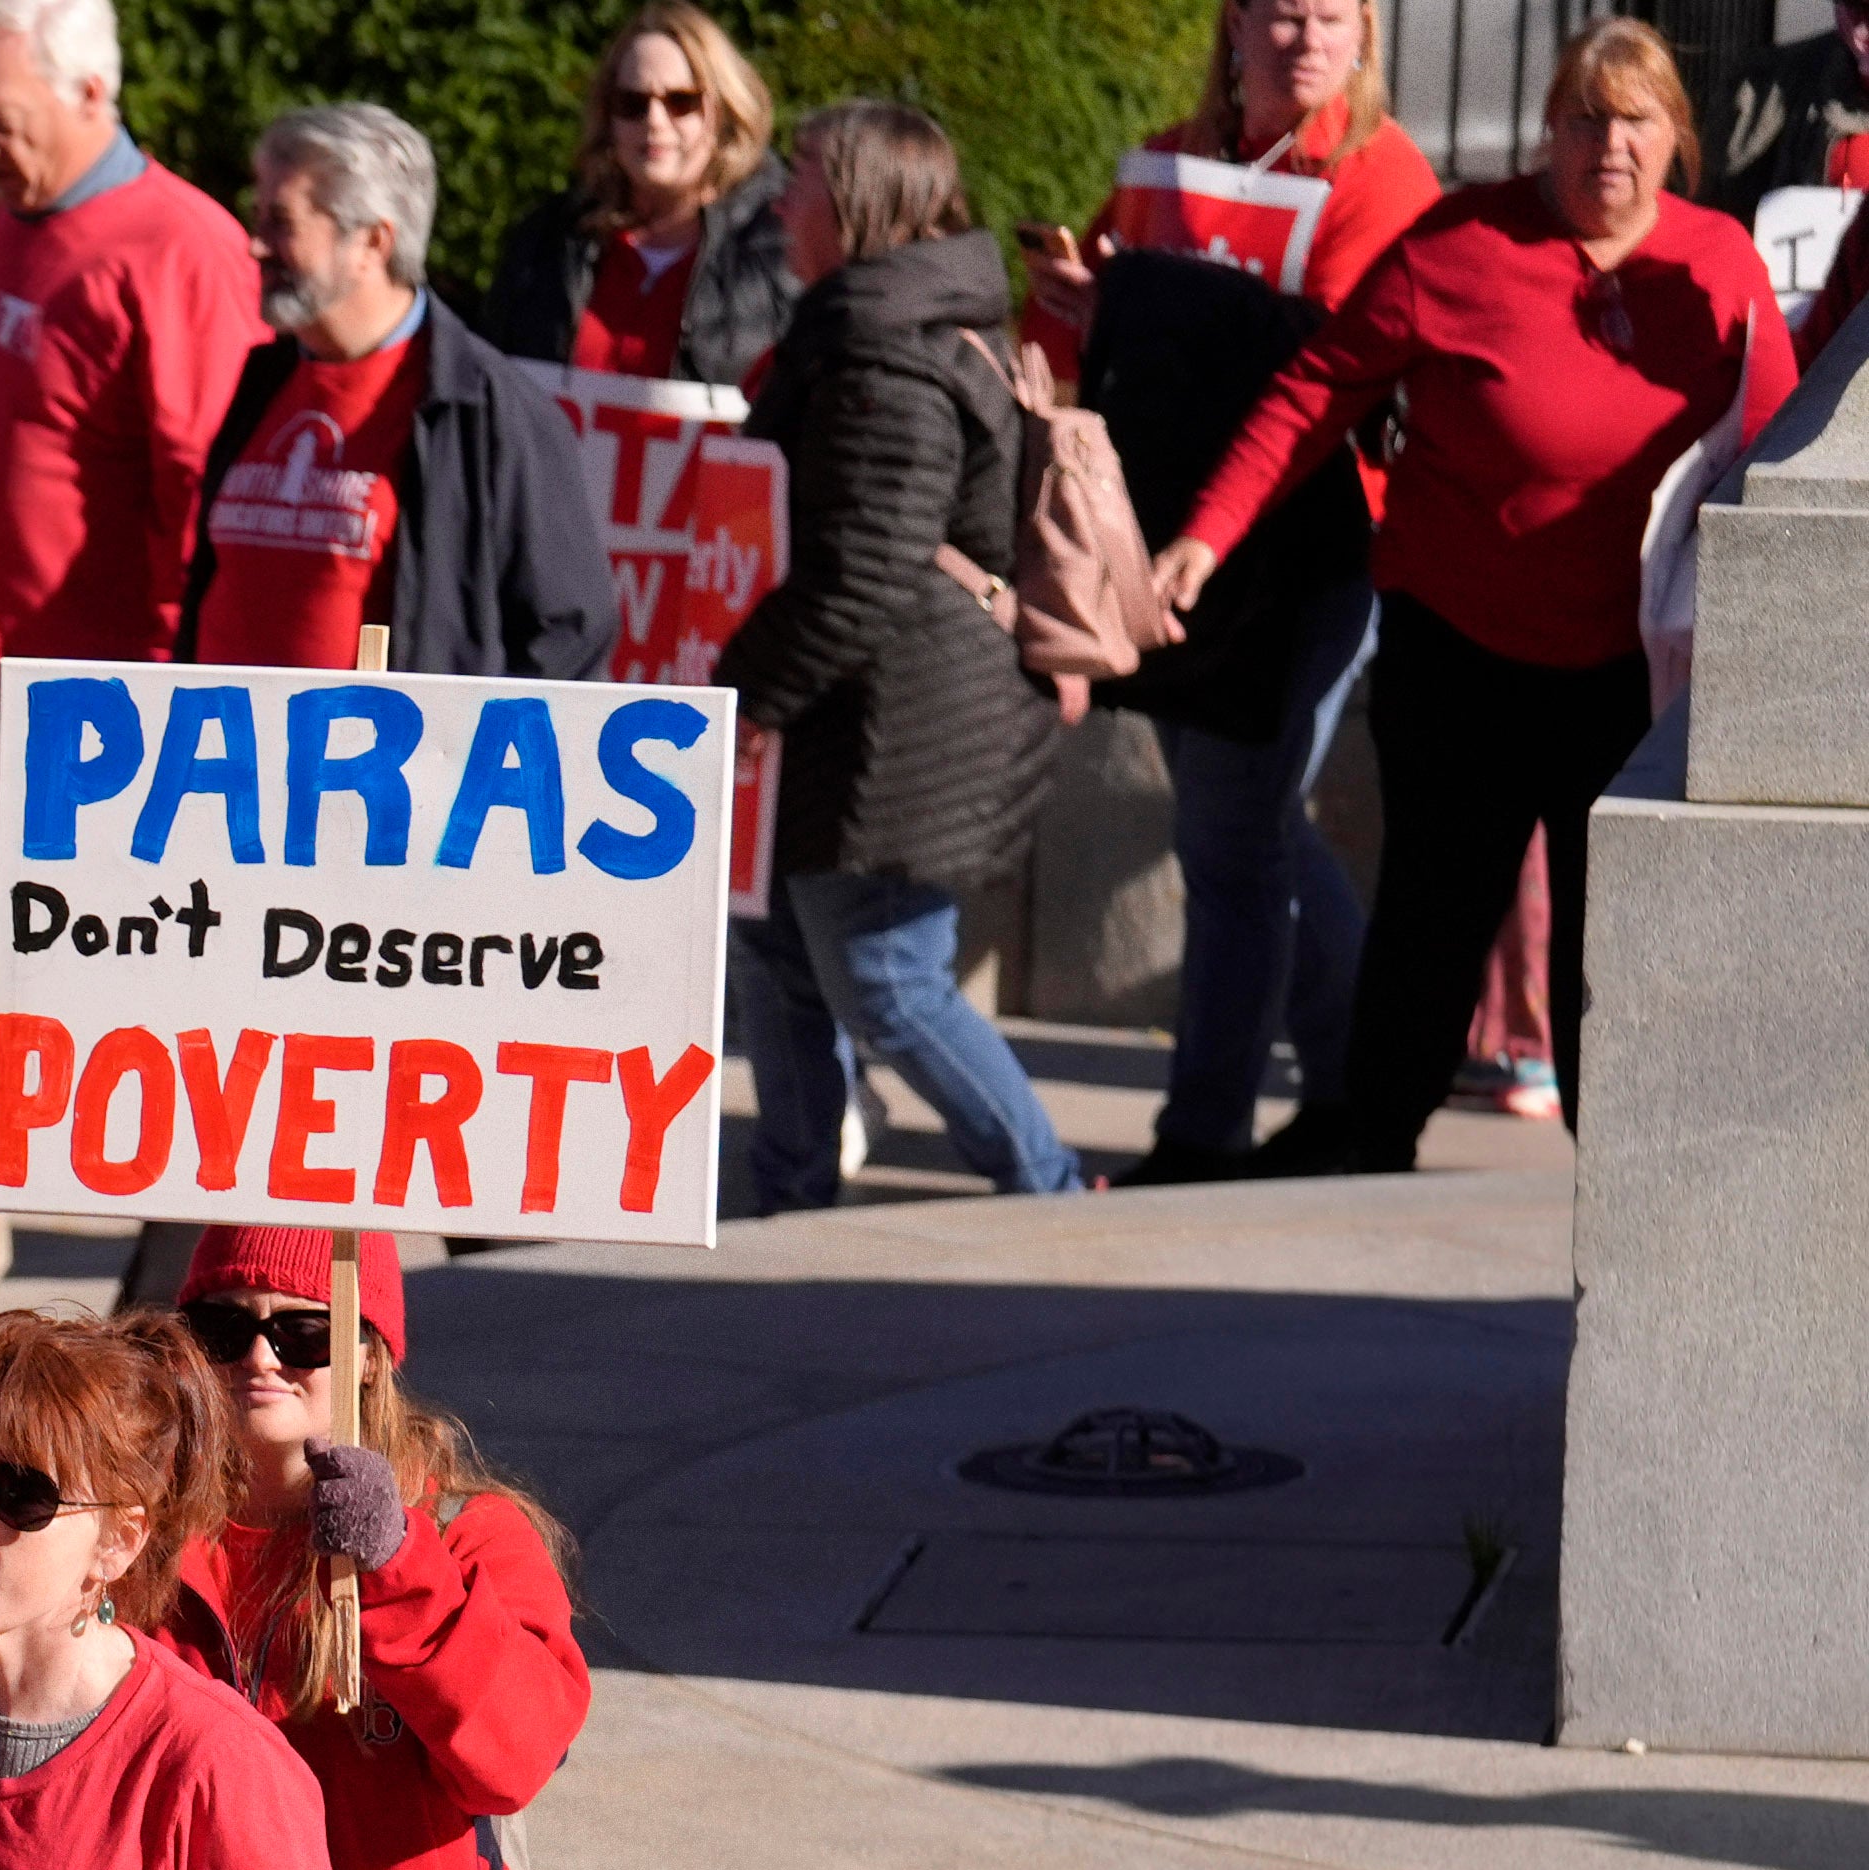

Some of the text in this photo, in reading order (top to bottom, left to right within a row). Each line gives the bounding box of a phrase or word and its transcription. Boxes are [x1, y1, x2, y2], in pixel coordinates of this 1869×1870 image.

[22, 676, 710, 880] PARAS
[10, 878, 604, 990] Don't Deserve
